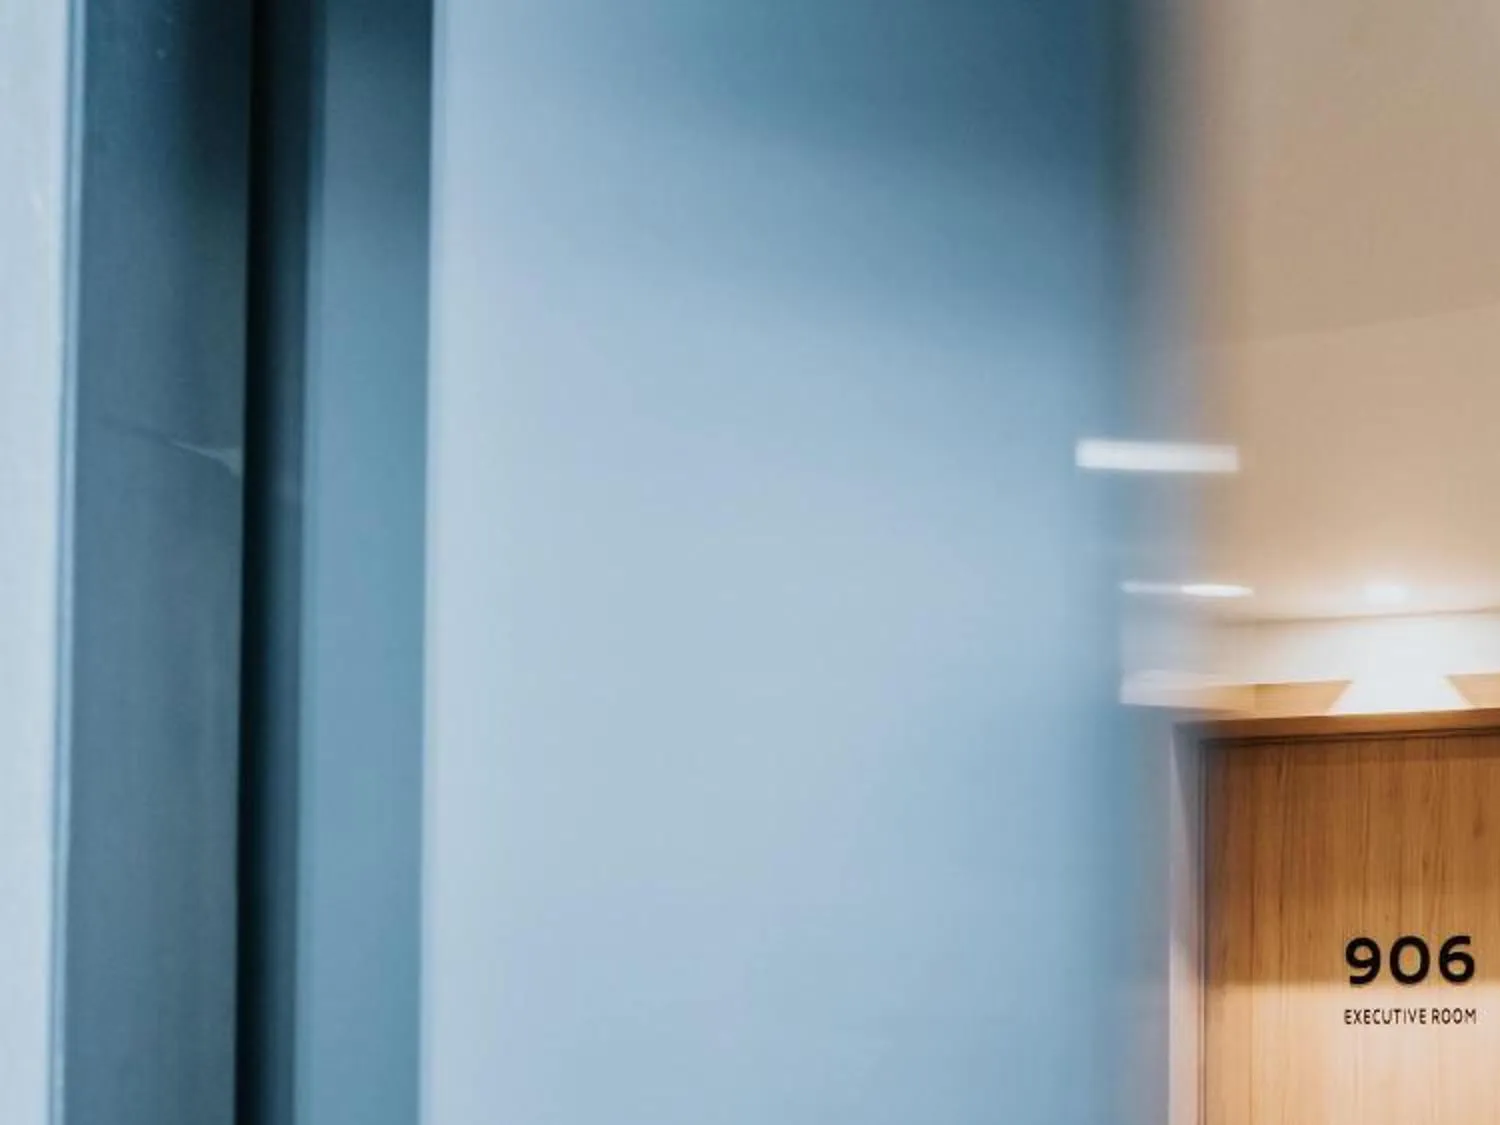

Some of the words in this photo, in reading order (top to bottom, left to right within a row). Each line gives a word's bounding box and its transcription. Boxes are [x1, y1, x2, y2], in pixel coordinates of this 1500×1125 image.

[1345, 935, 1475, 985] 906
[1344, 1008, 1426, 1025] EXECUTIVE
[1431, 1007, 1477, 1024] ROOM
